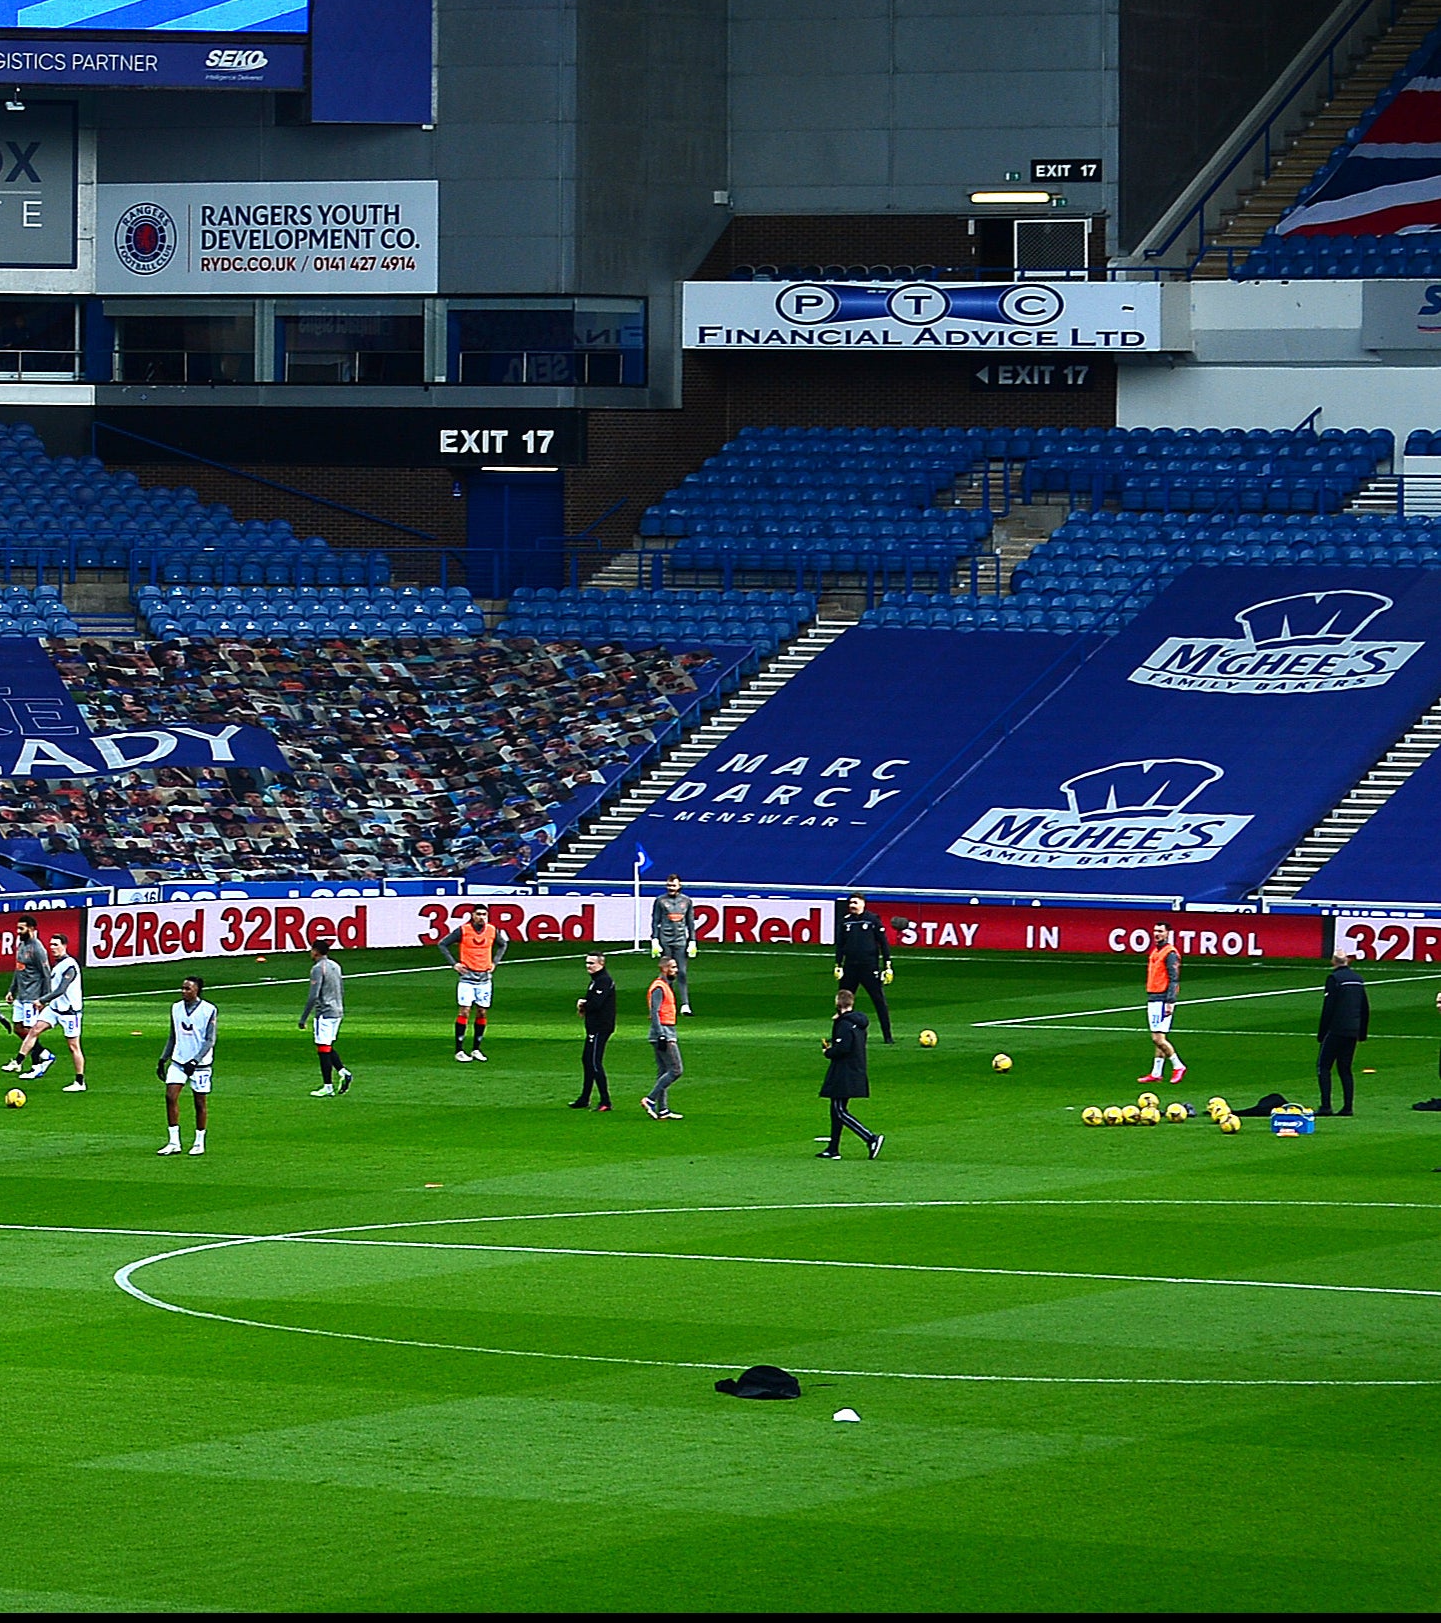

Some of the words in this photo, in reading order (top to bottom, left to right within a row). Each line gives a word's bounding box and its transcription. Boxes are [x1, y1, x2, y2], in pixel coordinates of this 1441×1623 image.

[71, 53, 158, 73] PARTNER
[205, 49, 268, 69] SEKO
[1036, 165, 1071, 177] EXIT
[1080, 164, 1097, 177] 17
[122, 206, 170, 227] RANGERS
[201, 204, 311, 226] RANGERS
[318, 204, 400, 226] YOUTH
[201, 229, 376, 251] DEVELOPMENT
[380, 228, 421, 249] CO.
[201, 256, 296, 272] RYDC.CO.UK
[313, 256, 345, 271] 0141
[350, 256, 378, 271] 427
[380, 256, 415, 270] 4914
[794, 294, 823, 314] P
[904, 295, 933, 315] T
[1015, 294, 1047, 315] C
[697, 326, 903, 345] FINANCIAL
[912, 327, 1058, 346] ADVICE
[997, 366, 1055, 385] EXIT
[1063, 366, 1089, 385] 17
[440, 429, 508, 453] EXIT
[521, 429, 554, 454] 17
[1147, 673, 1239, 691] FAMILY
[1255, 675, 1368, 691] BAKERS
[716, 753, 911, 780] MARC
[666, 781, 901, 809] DARCY
[673, 811, 840, 827] MENSWEAR
[966, 845, 1061, 864] FAMILY
[1076, 849, 1194, 866] BAKERS
[92, 909, 204, 960] 32Red
[220, 905, 367, 952] 32Red
[692, 905, 822, 944] 2Red
[901, 921, 979, 947] STAY
[1026, 925, 1059, 950] IN
[1108, 928, 1263, 957] COTROL
